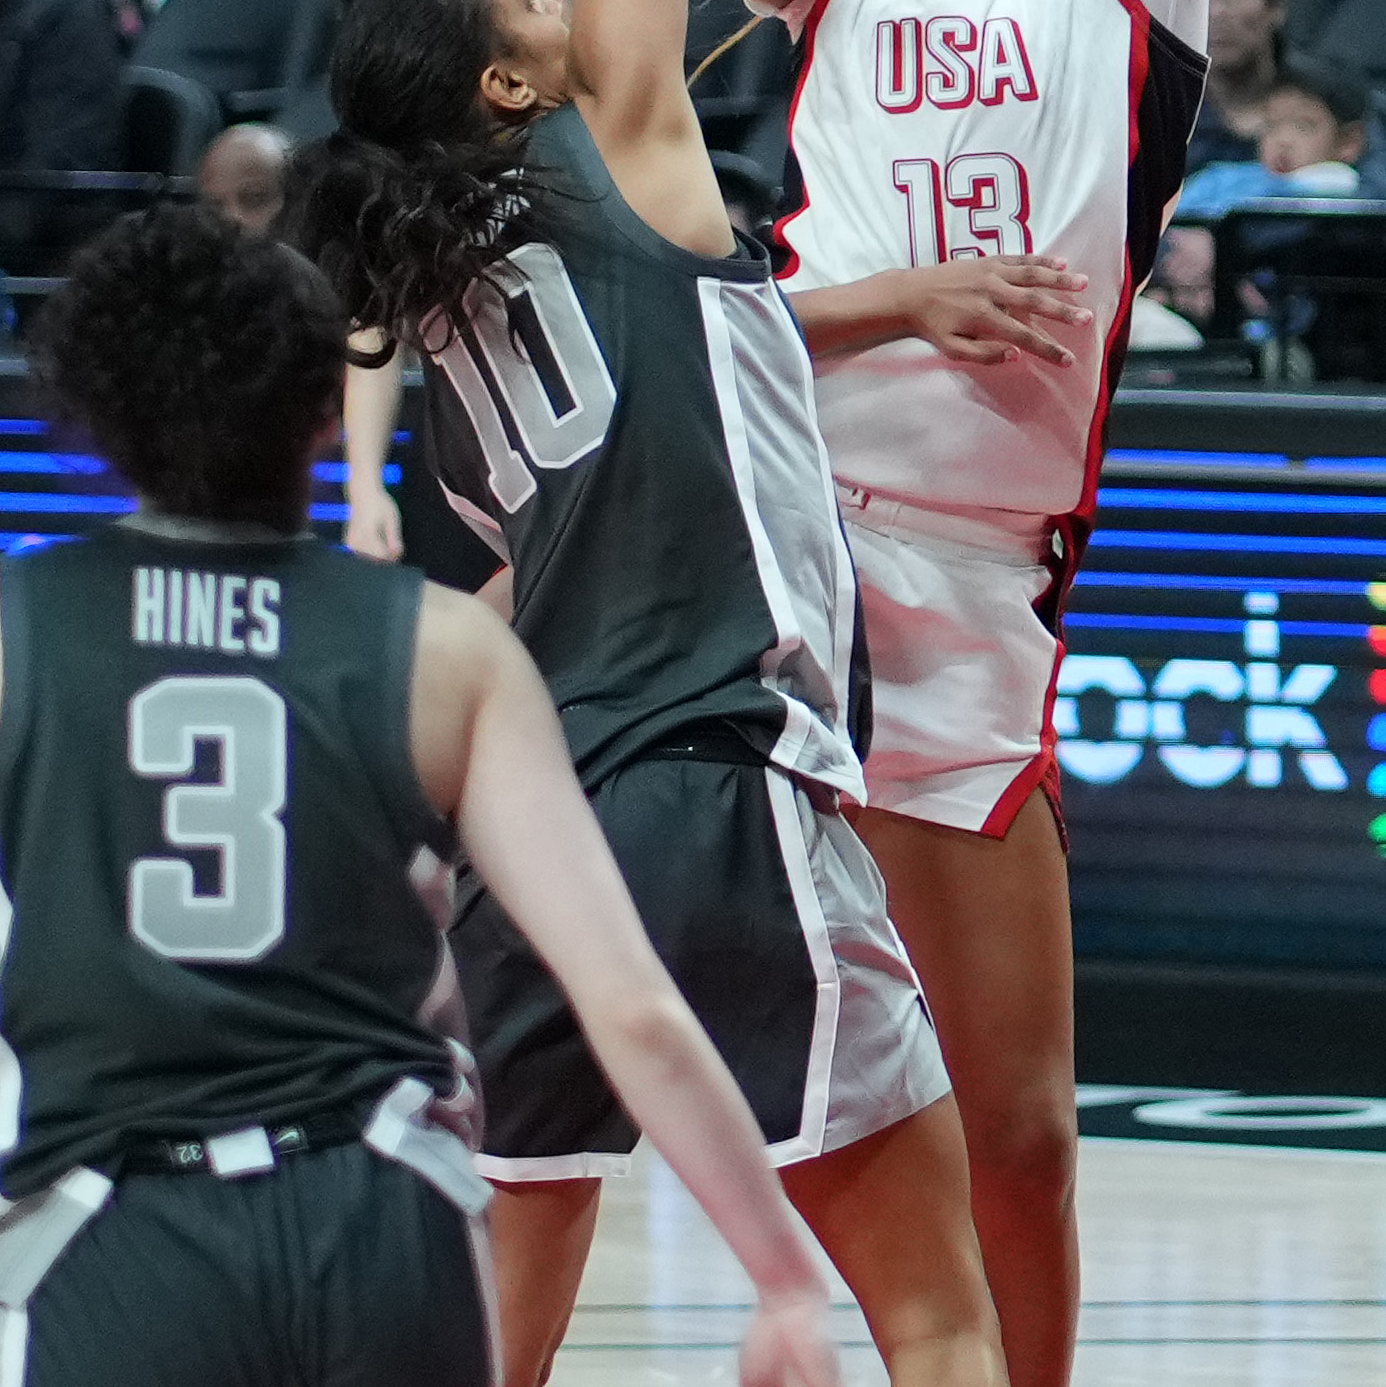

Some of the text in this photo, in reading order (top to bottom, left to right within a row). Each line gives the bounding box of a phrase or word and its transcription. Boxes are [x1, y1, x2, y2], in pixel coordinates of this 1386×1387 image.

[875, 15, 1039, 114] USA
[892, 152, 1034, 270] 13
[418, 242, 617, 514] 10
[133, 566, 280, 659] HINES
[1055, 590, 1348, 791] ock
[130, 677, 287, 958] 3
